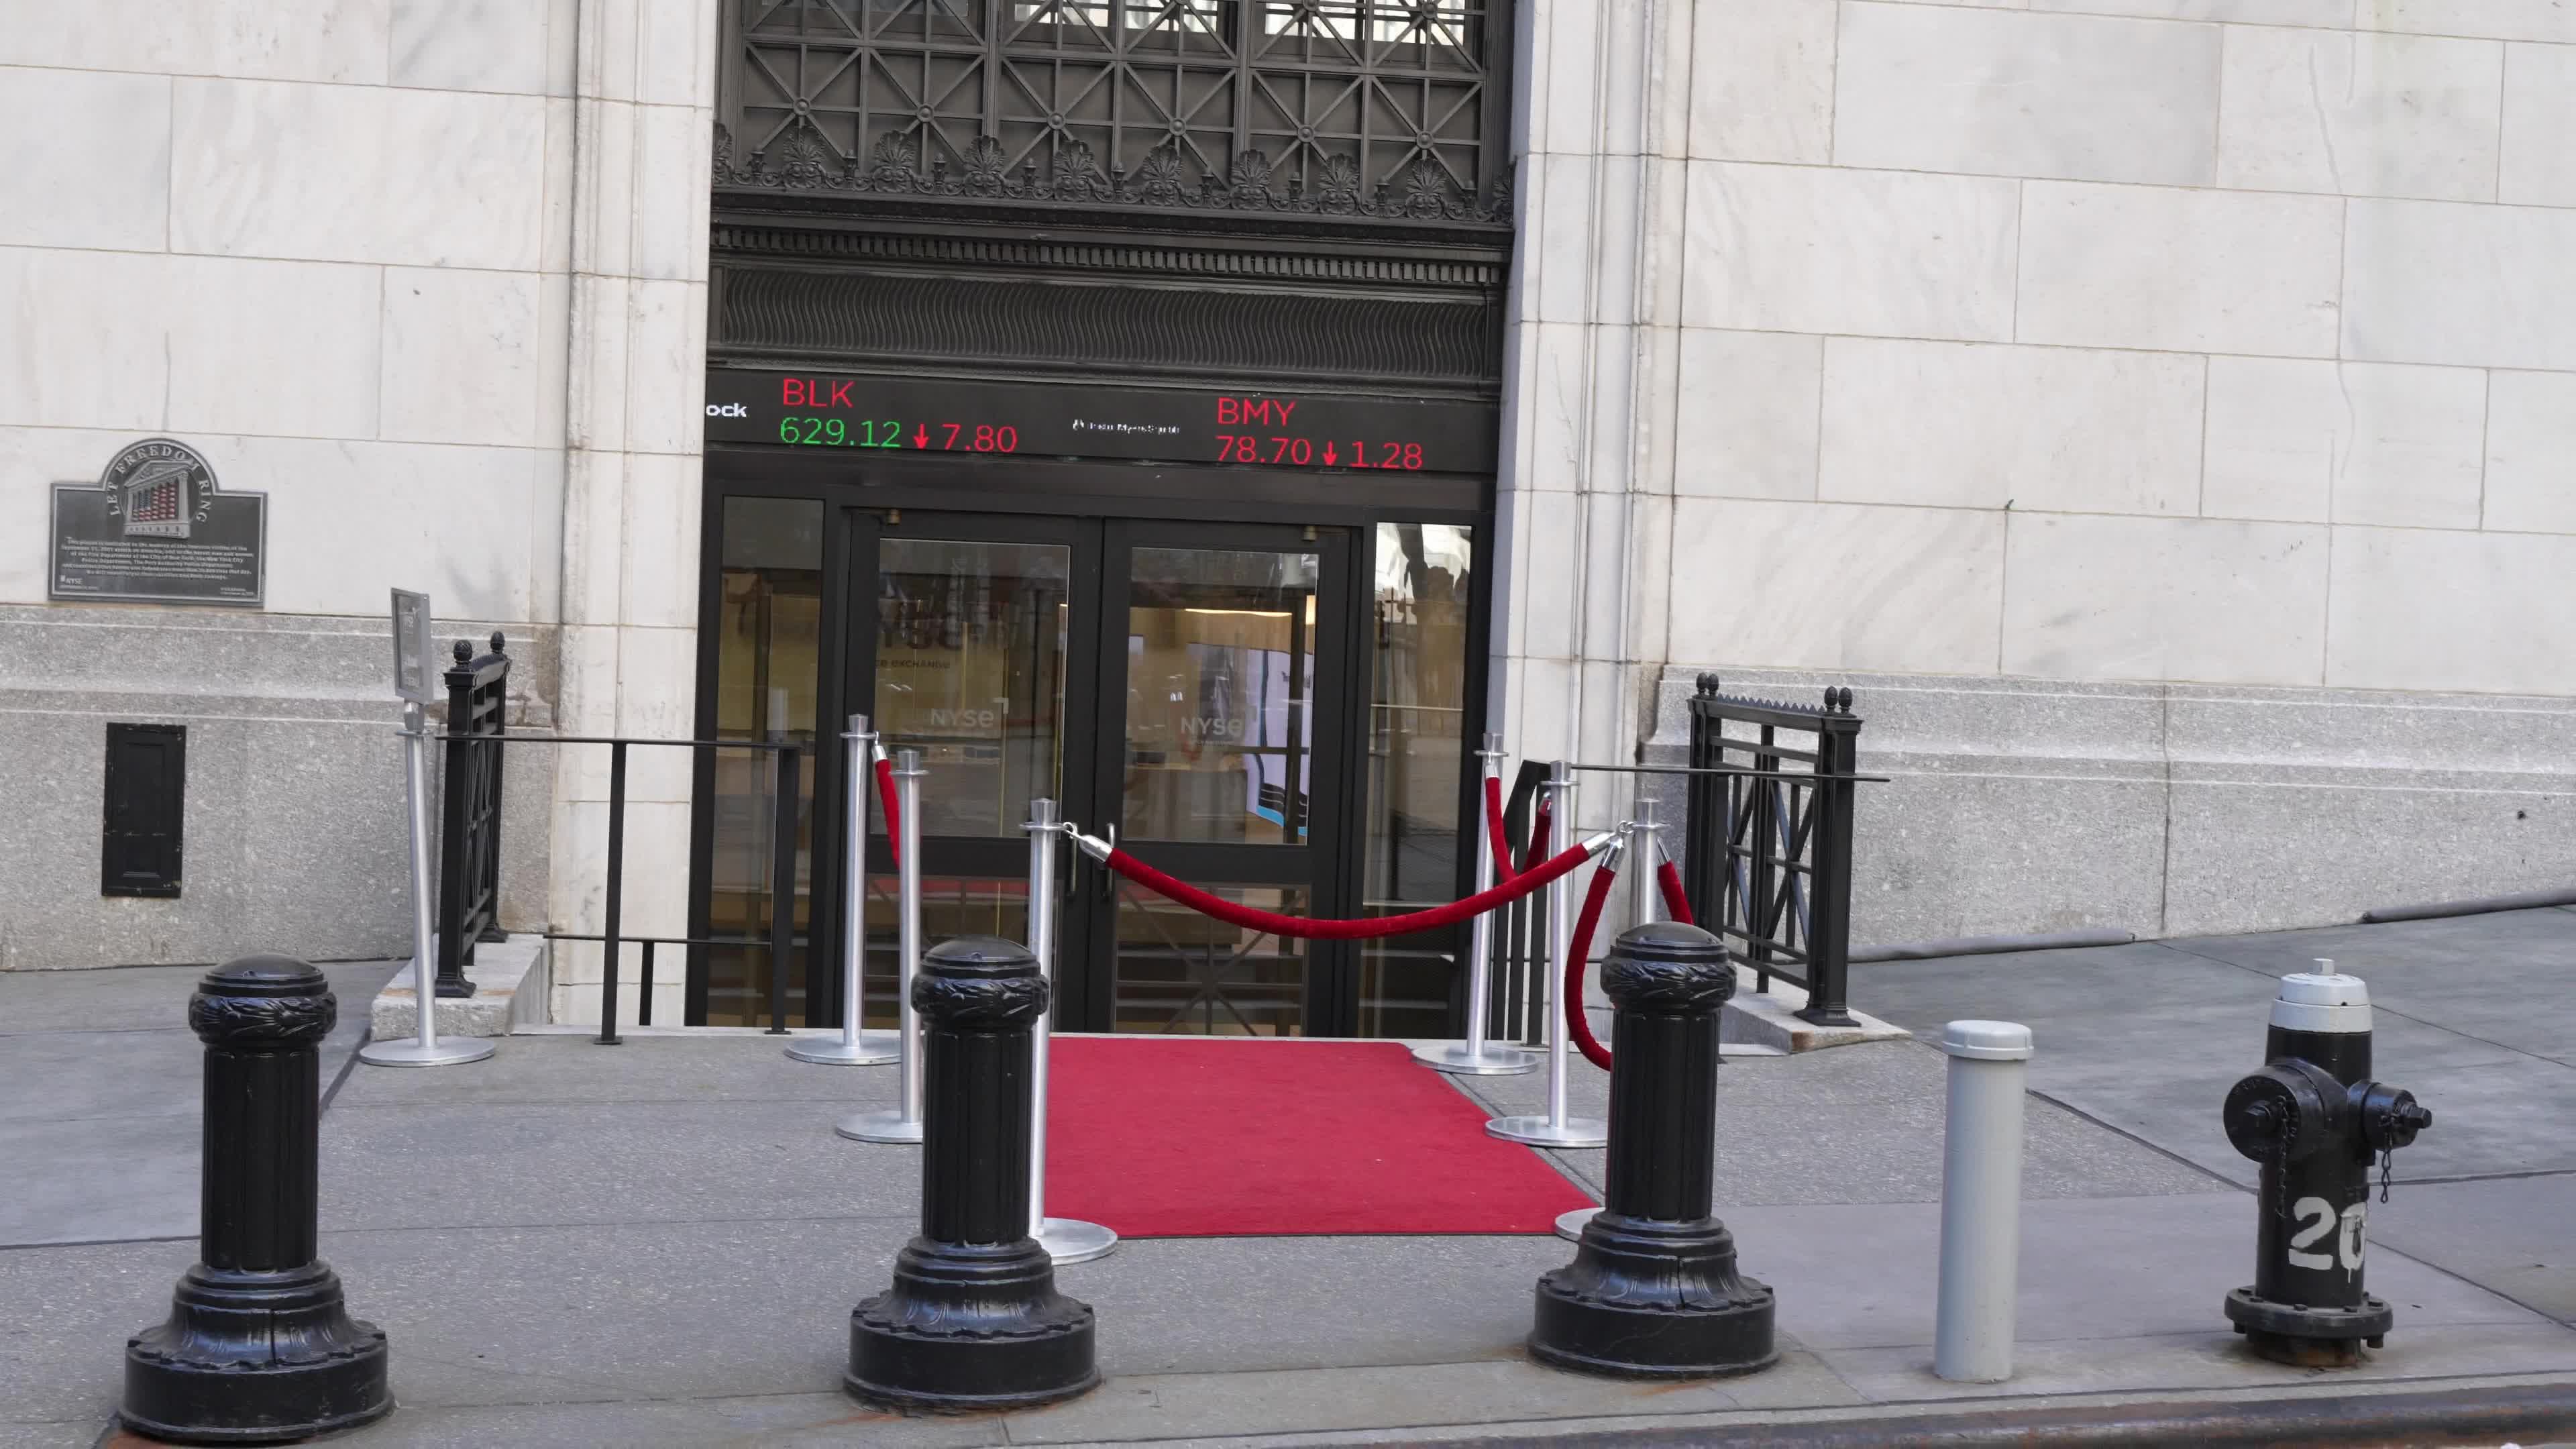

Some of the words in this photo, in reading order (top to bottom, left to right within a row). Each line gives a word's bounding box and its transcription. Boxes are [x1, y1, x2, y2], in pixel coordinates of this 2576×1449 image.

[783, 378, 855, 409] BLK
[1217, 396, 1297, 427] BMY
[780, 417, 902, 447] 629.12
[942, 423, 1018, 453] 7.80
[1216, 435, 1311, 466] 78.70
[1350, 441, 1424, 470] 1.28
[107, 481, 121, 516] LET
[196, 480, 212, 523] RING
